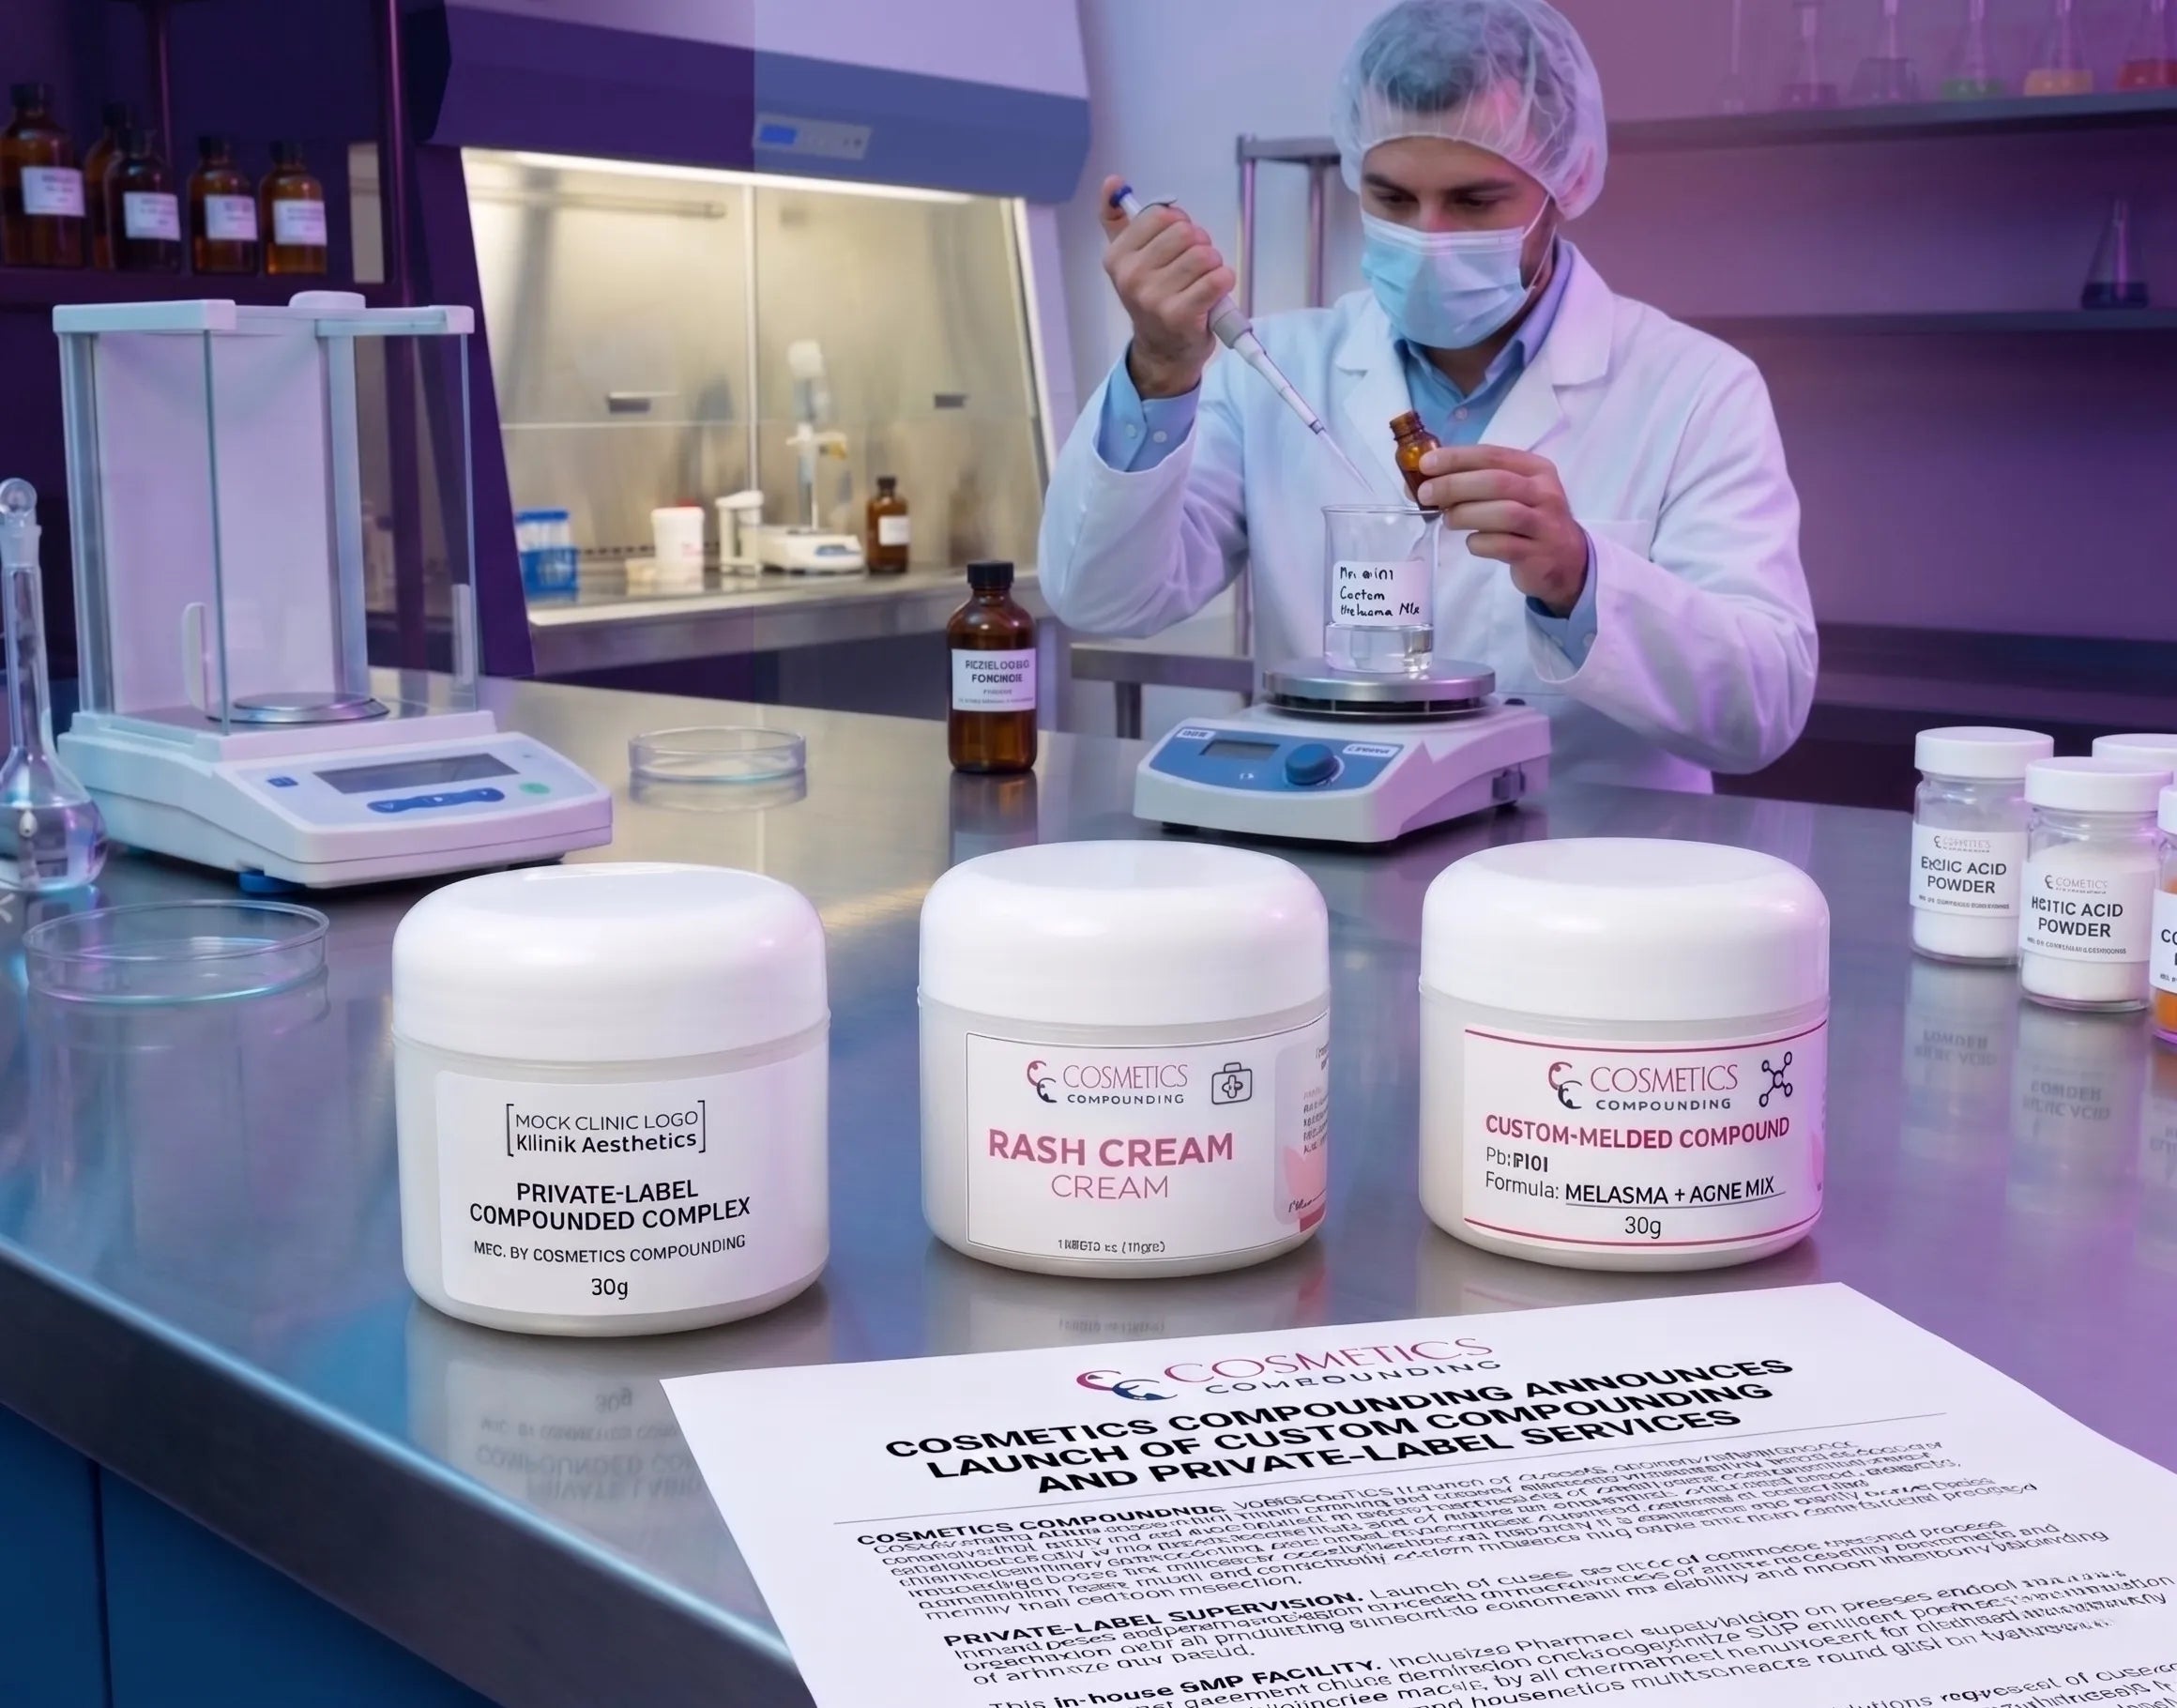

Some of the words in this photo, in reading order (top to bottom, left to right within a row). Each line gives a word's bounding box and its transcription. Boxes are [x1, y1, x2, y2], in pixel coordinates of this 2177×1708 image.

[1967, 862, 2007, 876] ACID
[1927, 875, 1995, 893] POWDER
[2080, 903, 2124, 917] ACID
[2038, 917, 2110, 938] POWDER
[1063, 1063, 1188, 1089] COSMETICS
[1591, 1064, 1738, 1092] COSMETICS
[1067, 1094, 1185, 1105] COMPOUNDING
[1596, 1098, 1731, 1111] COMPOUNDING
[516, 1114, 571, 1130] MOCK
[575, 1115, 639, 1131] CLINIC
[645, 1111, 698, 1128] LOGO
[1485, 1114, 1672, 1149] CUSTOM-MELDED
[1680, 1117, 1789, 1149] COMPOUND
[582, 1133, 697, 1153] Aesthetics
[989, 1129, 1085, 1167] RASH
[1099, 1133, 1233, 1167] CREAM
[517, 1180, 699, 1204] PRIVATE-LABEL
[1051, 1174, 1168, 1199] CREAM
[1485, 1171, 1559, 1200] Formula:
[1565, 1183, 1668, 1205] MELASMA
[1690, 1181, 1742, 1203] AGNE
[1745, 1176, 1774, 1195] MIX
[470, 1202, 634, 1230] COMPOUNDED
[643, 1197, 751, 1228] COMPLEX
[1624, 1216, 1661, 1239] 30g
[510, 1245, 528, 1260] BY
[534, 1248, 625, 1263] COSMETICS
[630, 1234, 746, 1262] COMPOUNDING
[591, 1277, 629, 1300] 30g
[1165, 1338, 1493, 1383] COSMETICS
[886, 1419, 1163, 1457] COSMETICS
[1168, 1385, 1513, 1431] COMPOUNDING
[1526, 1360, 1794, 1397] ANNOUNCES
[927, 1445, 1128, 1478] LAUNCH
[1140, 1438, 1203, 1457] OF
[1210, 1419, 1417, 1450] CUSTOM
[1427, 1383, 1773, 1429] COMPOUNDING
[1039, 1471, 1138, 1494] AND
[1149, 1432, 1514, 1484] PRIVATE-LABEL
[1521, 1411, 1741, 1446] SERVICES
[858, 1522, 1013, 1545] COSMETICS
[2019, 1522, 2061, 1536] and
[1756, 1565, 1799, 1580] and
[944, 1613, 1163, 1647] PRIVATE-LABEL
[1168, 1592, 1363, 1623] SUPERVISION.
[1370, 1580, 1460, 1599] Launch
[1467, 1578, 1491, 1589] of
[1053, 1686, 1174, 1708] in-house
[1180, 1675, 1243, 1693] SMP
[1252, 1659, 1381, 1685] FACILITY.
[1804, 1605, 1837, 1616] on
[1817, 1643, 1888, 1665] round
[1493, 1674, 1523, 1688] by
